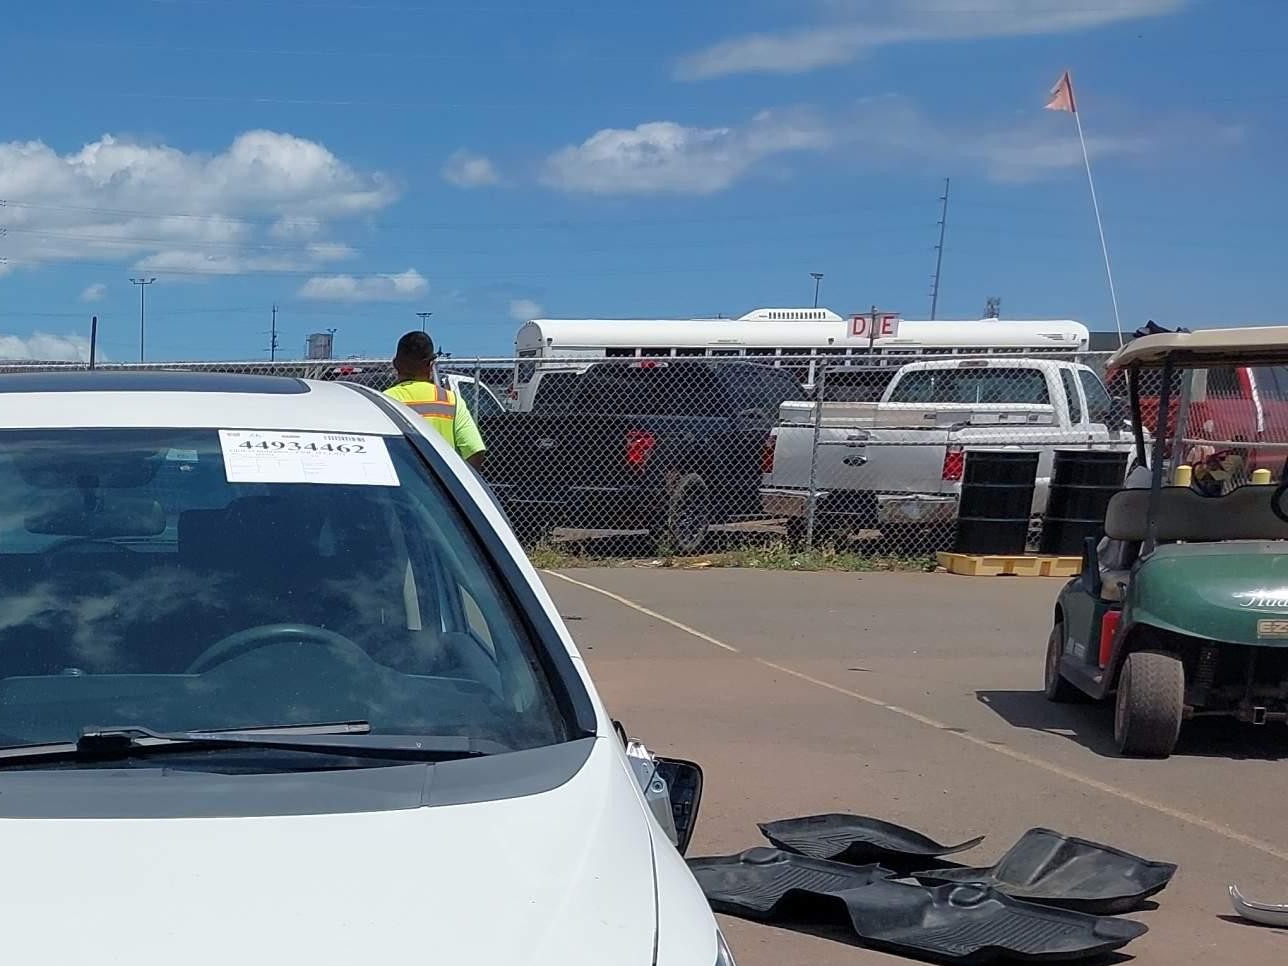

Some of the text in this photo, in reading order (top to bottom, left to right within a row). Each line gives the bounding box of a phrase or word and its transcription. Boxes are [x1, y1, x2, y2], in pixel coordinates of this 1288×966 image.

[852, 316, 867, 335] D
[881, 316, 895, 335] E
[238, 440, 367, 455] 44934462
